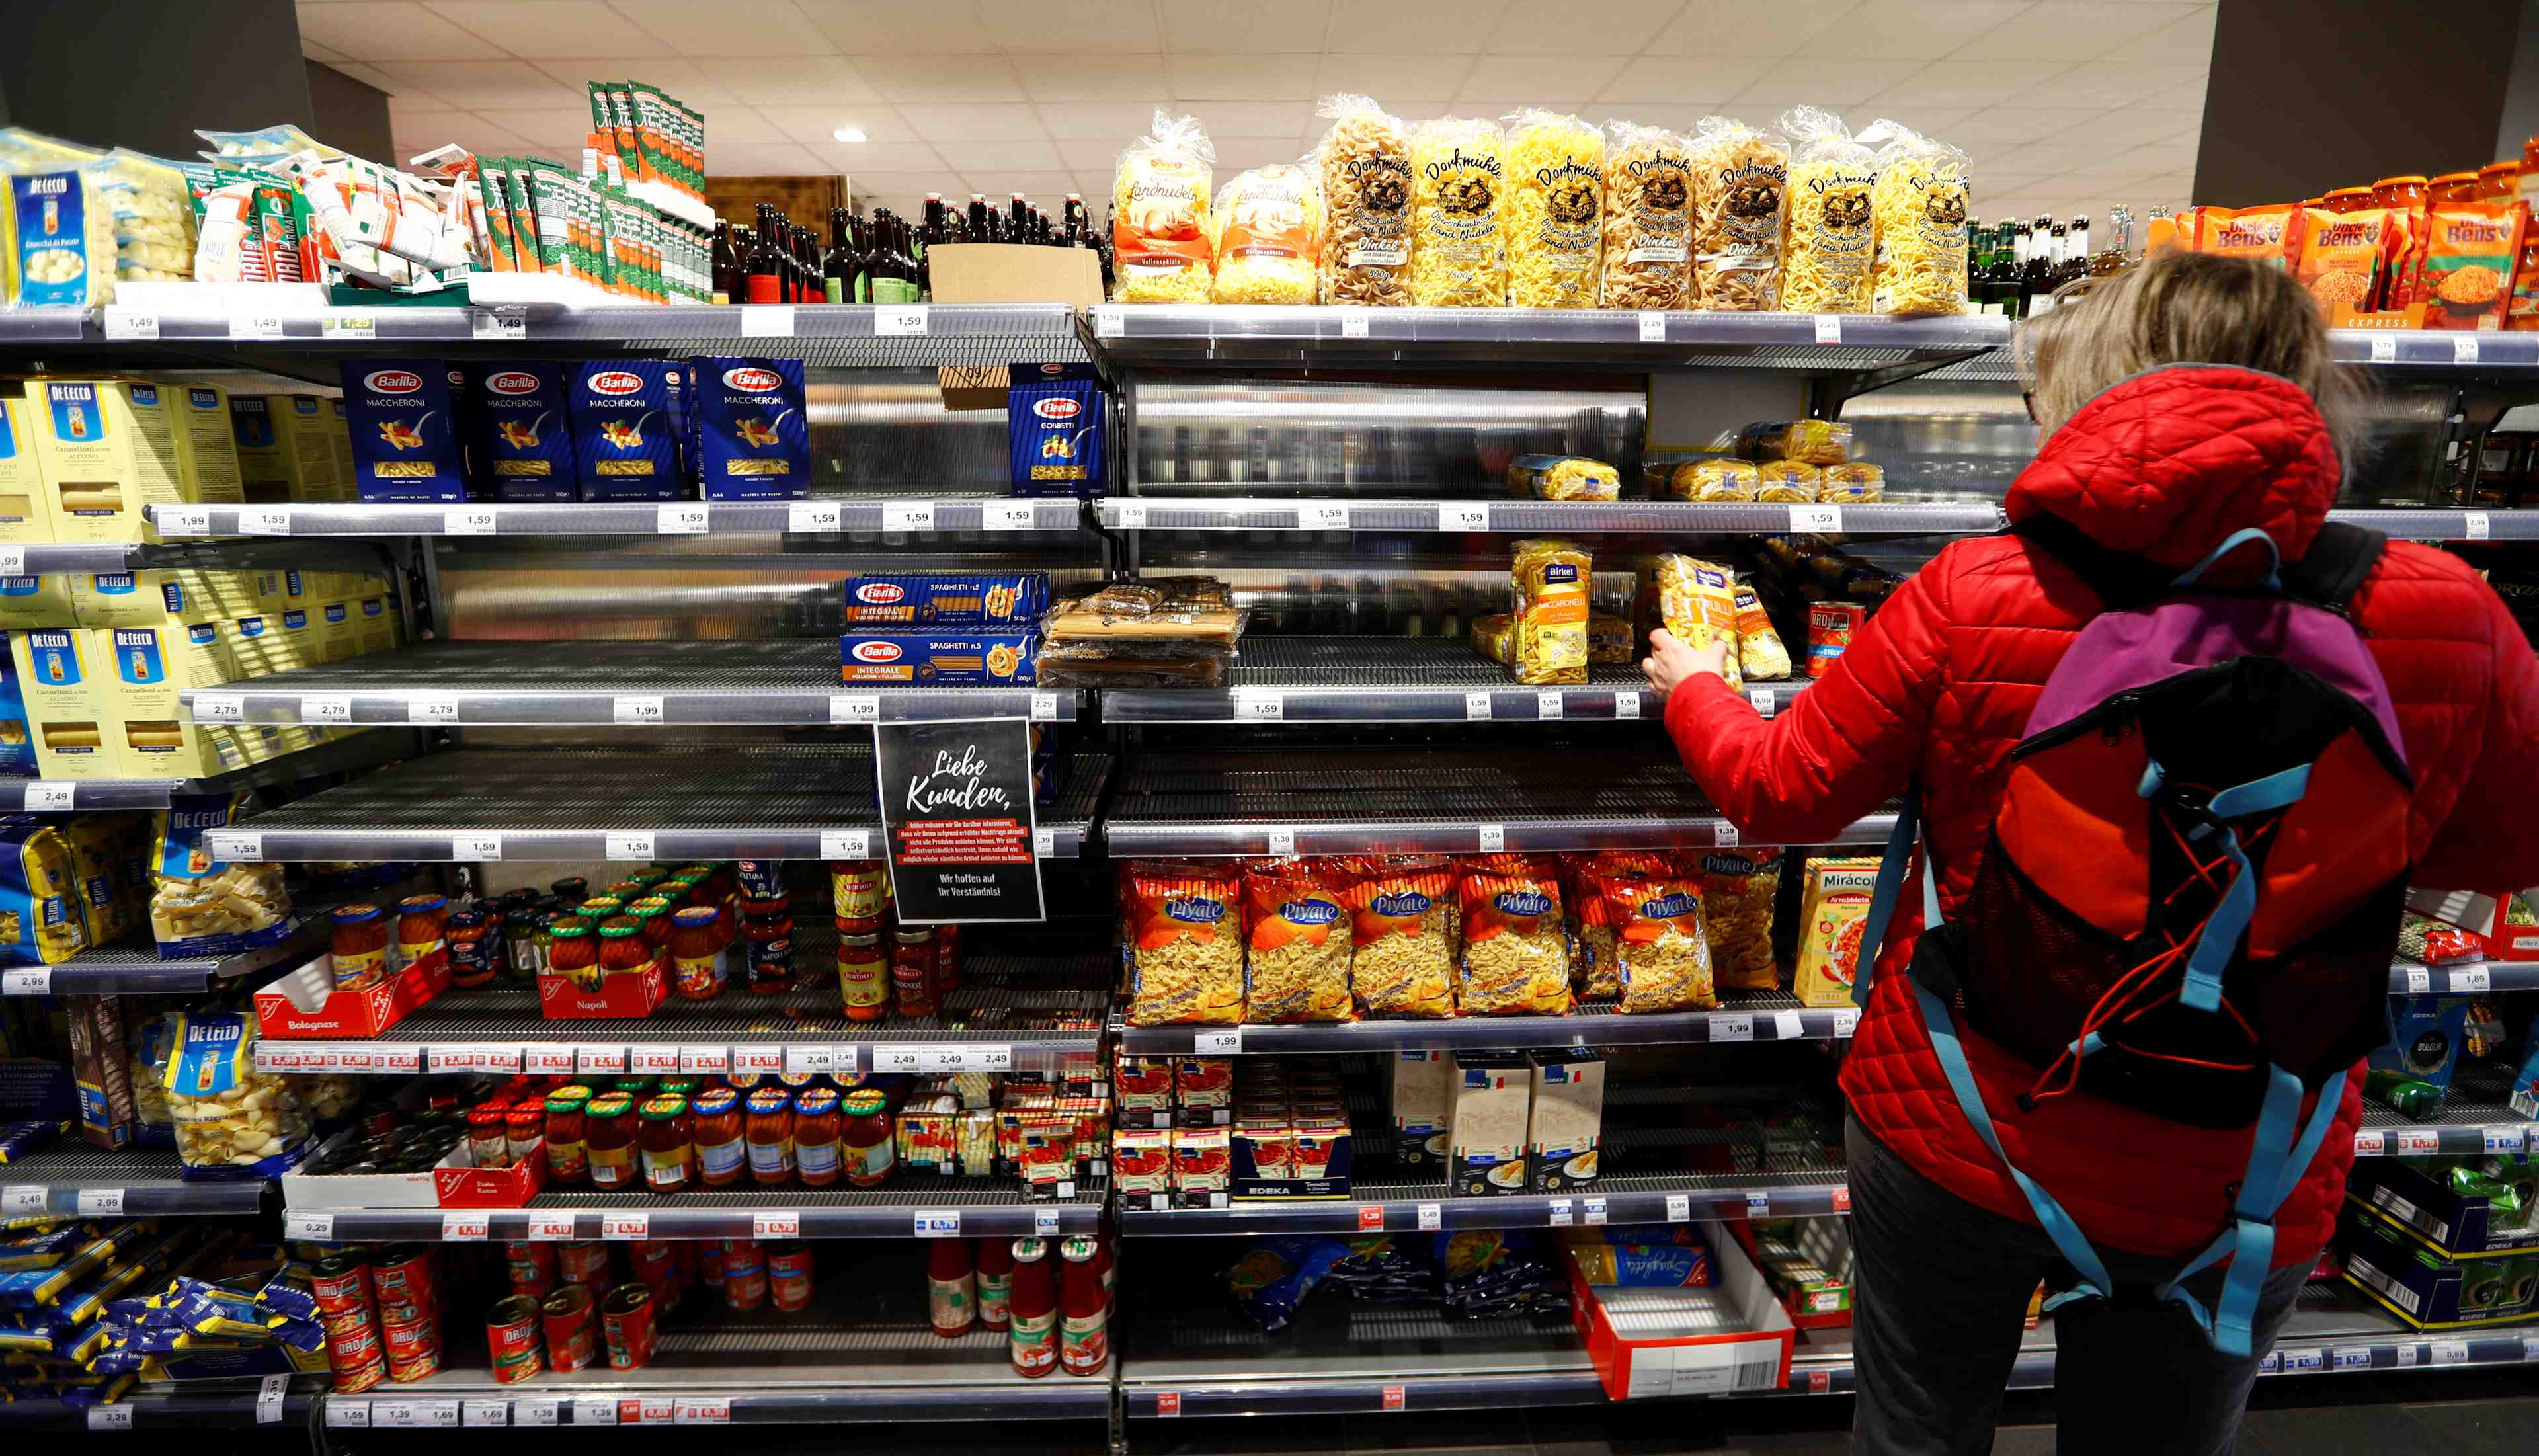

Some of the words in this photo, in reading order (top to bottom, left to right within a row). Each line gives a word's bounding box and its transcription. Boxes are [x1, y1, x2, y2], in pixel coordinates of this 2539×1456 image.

[1426, 147, 1503, 181] Dorfmühle
[1126, 181, 1199, 202] Landnudeln
[2229, 221, 2264, 233] Uncle
[2332, 222, 2366, 233] Uncle
[1638, 233, 1679, 249] Dinkel
[2317, 228, 2363, 248] Ben's
[1357, 236, 1400, 252] Dinkel
[1369, 269, 1392, 282] 500g
[128, 317, 153, 328] 1,49
[252, 317, 278, 328] 1,49
[497, 318, 522, 329] 1,49
[897, 317, 922, 326] 1,59
[2348, 317, 2410, 329] EXPRESS
[377, 375, 417, 391] Barilla
[497, 377, 536, 391] Barilla
[600, 375, 641, 391] Barilla
[736, 372, 779, 387] Barilla
[589, 399, 646, 408] MACCHERONI
[723, 395, 784, 405] MACCHERONI
[1043, 401, 1077, 415] Barilla
[679, 513, 704, 522] 1,59
[811, 514, 836, 523] 1,59
[905, 513, 929, 522] 1,59
[1005, 511, 1029, 520] 1,59
[1318, 508, 1342, 519] 1,59
[1459, 512, 1483, 523] 1,59
[1810, 513, 1834, 524] 1,59
[181, 516, 205, 526] 1,99
[261, 514, 286, 525] 1,59
[467, 515, 491, 525] 1,59
[1549, 567, 1574, 577] Birkel
[1811, 613, 1828, 627] ORO
[864, 646, 898, 657] Barilla
[1542, 698, 1559, 708] 1,59
[214, 705, 239, 715] 2,79
[321, 705, 346, 715] 2,79
[429, 704, 454, 715] 2,79
[1256, 704, 1277, 714] 1,59
[931, 744, 988, 778] Liebe
[44, 791, 69, 802] 2,49
[905, 776, 1011, 814] Kunden,
[233, 844, 257, 854] 1,59
[625, 842, 649, 852] 1,59
[840, 842, 864, 852] 1,59
[1705, 855, 1753, 876] Piyale
[939, 873, 953, 884] Wir
[955, 873, 981, 883] hoffen
[982, 873, 996, 883] auf
[1824, 871, 1875, 889] Mirácol
[938, 887, 949, 897] Ihr
[951, 887, 1000, 897] Verständnis!
[1168, 899, 1221, 921] Piyale
[1375, 894, 1427, 917] Piyale
[1498, 894, 1549, 915] Piyale
[1645, 895, 1695, 919] Piyale
[1283, 903, 1337, 926] Piyale
[22, 977, 44, 987] 2,99
[2466, 975, 2485, 984] 1,89
[576, 1000, 608, 1010] Napoli
[288, 1020, 339, 1031] Bolognese
[1727, 1024, 1750, 1034] 1,99
[1215, 1036, 1237, 1047] 1,99
[2417, 1041, 2442, 1052] BULGUR
[447, 1055, 471, 1065] 2,99
[493, 1055, 517, 1065] 2,99
[651, 1056, 675, 1066] 2,19
[698, 1057, 723, 1067] 2,19
[752, 1056, 777, 1067] 2,19
[806, 1055, 830, 1065] 2,49
[892, 1055, 916, 1065] 2,49
[939, 1054, 962, 1064] 2,49
[985, 1054, 1008, 1064] 2,49
[19, 1195, 42, 1204] 2,49
[96, 1198, 118, 1207] 2,99
[305, 1223, 328, 1233] 0,29
[772, 1222, 795, 1233] 0,79
[932, 1219, 957, 1230] 0,79
[2485, 1242, 2513, 1251] EDEKA
[1625, 1251, 1691, 1279] Spaghetti
[337, 1340, 360, 1354] ORO
[2349, 1355, 2368, 1365] 1,99
[2446, 1350, 2465, 1359] 0,99
[2300, 1357, 2320, 1367] 1,99
[389, 1409, 411, 1418] 1,39
[481, 1409, 503, 1418] 1,69
[532, 1408, 553, 1418] 1,39
[590, 1407, 612, 1417] 1,39
